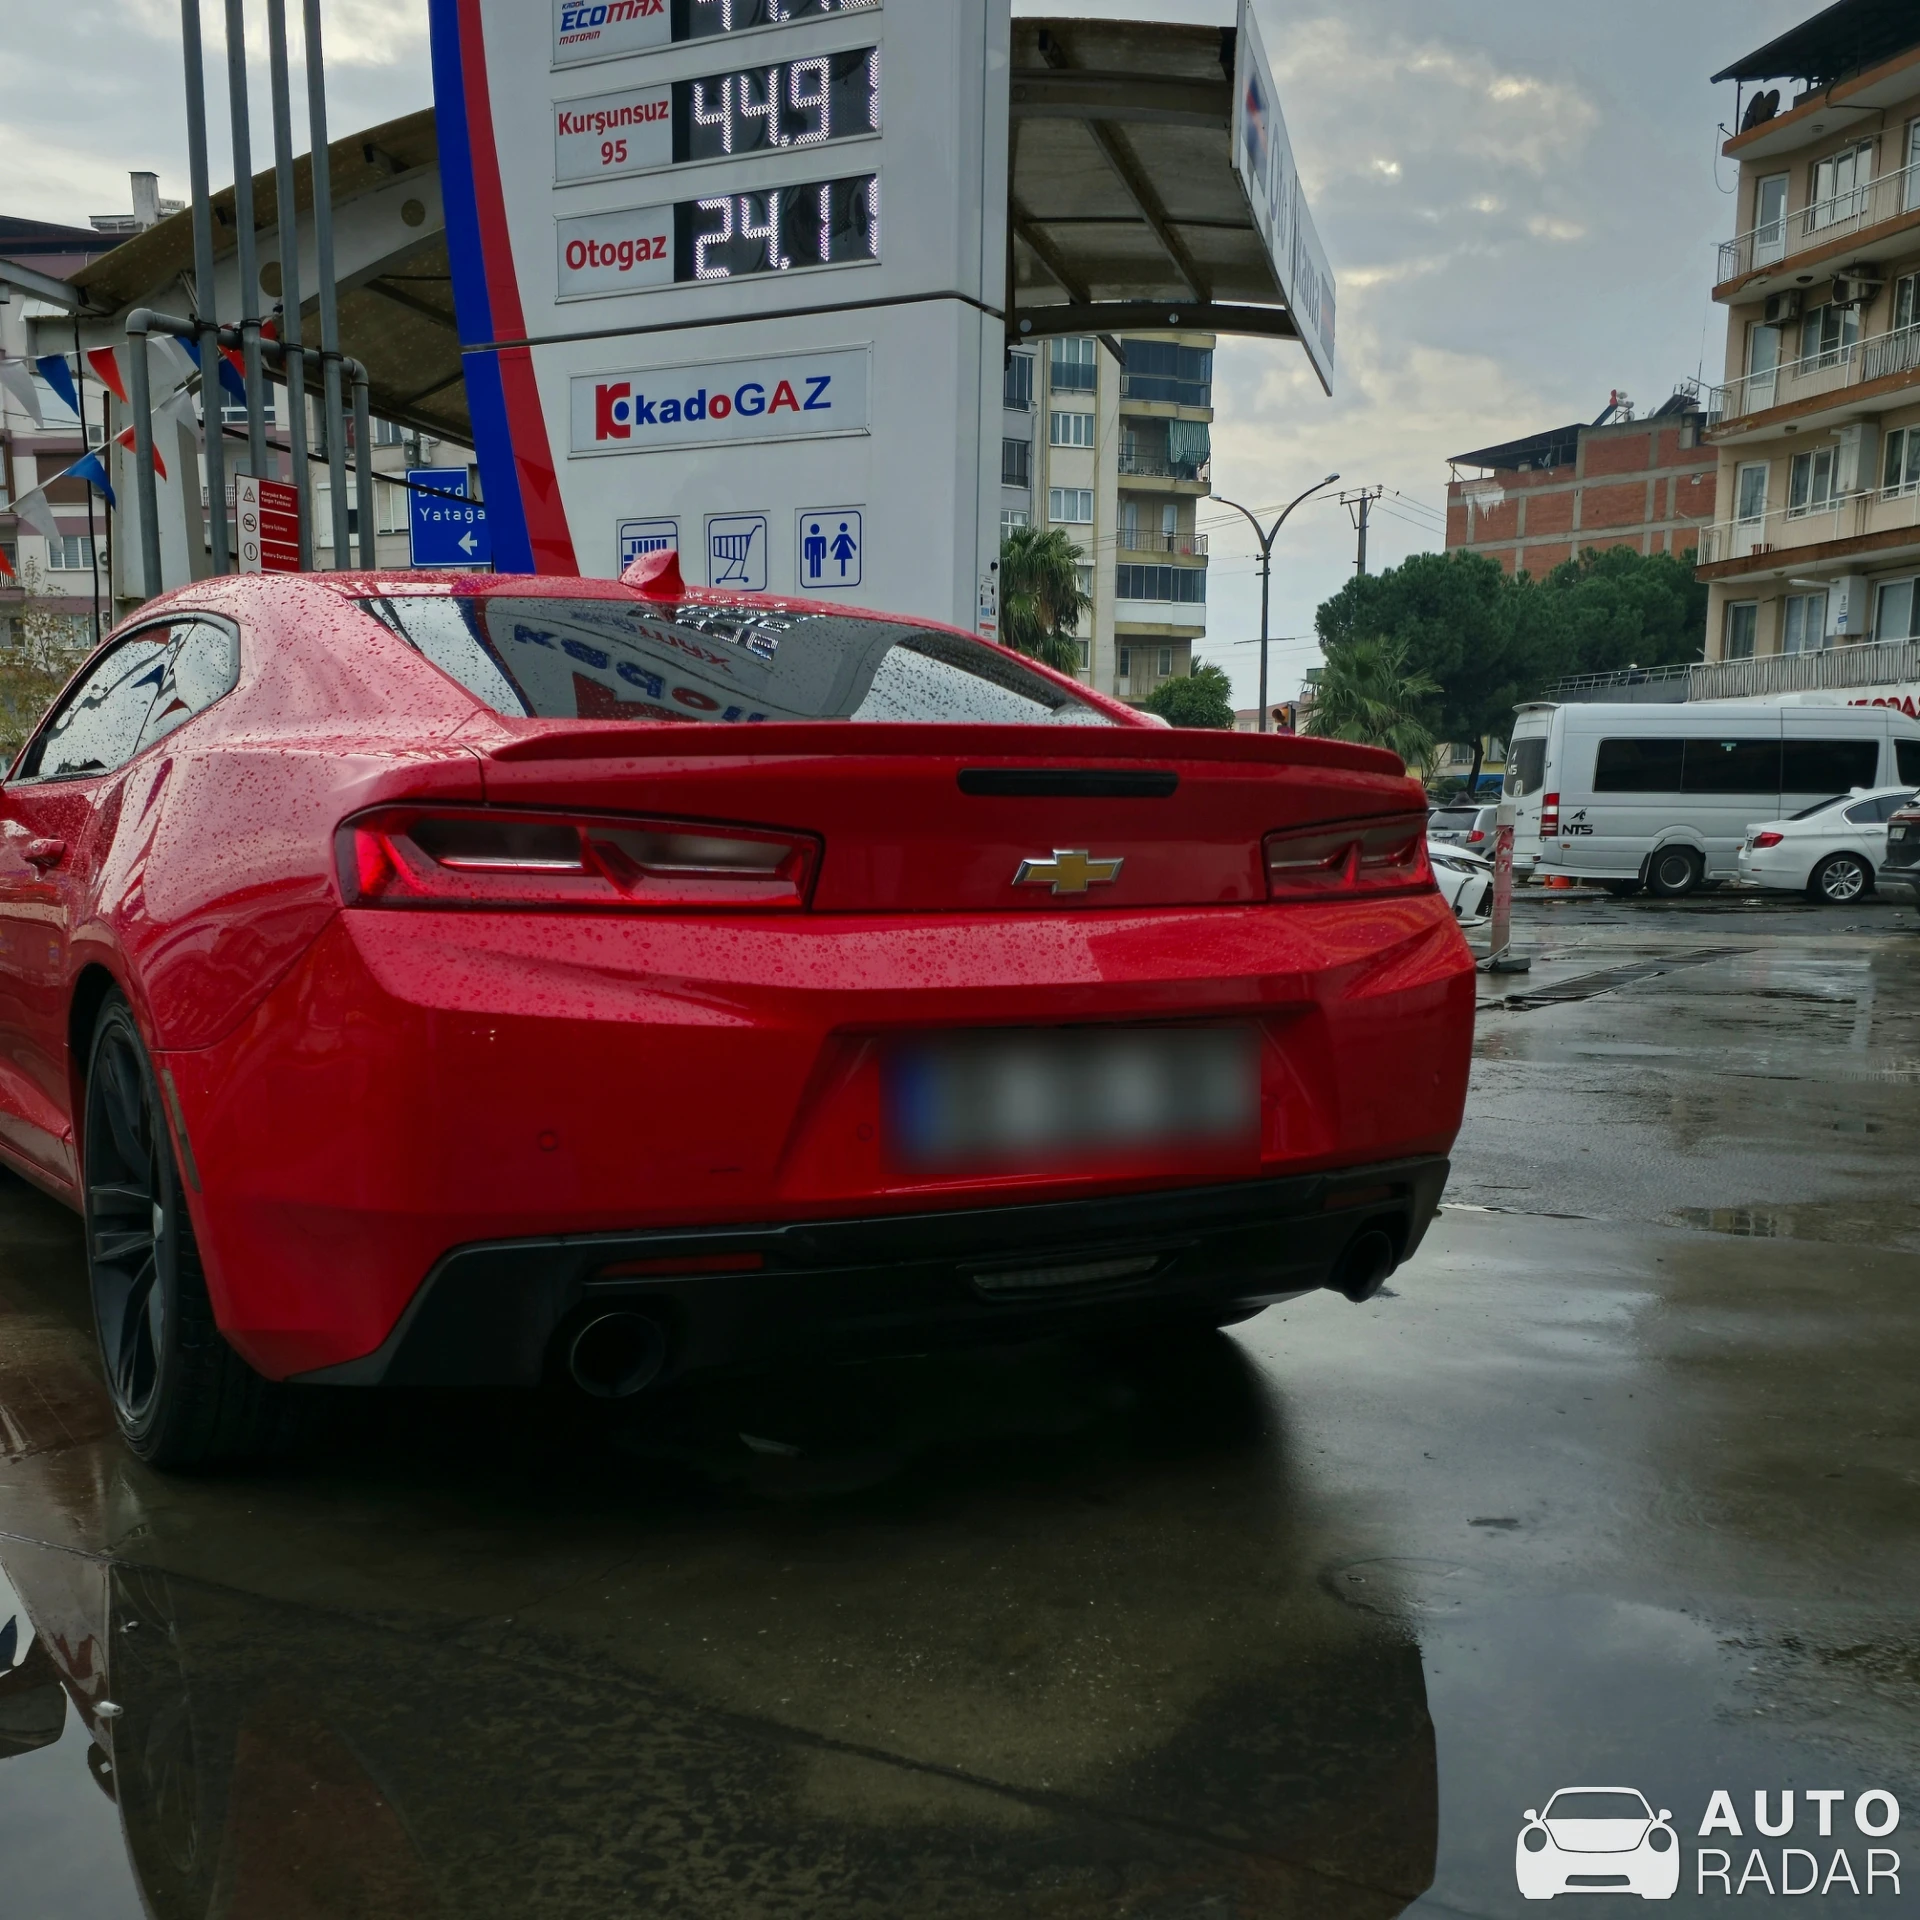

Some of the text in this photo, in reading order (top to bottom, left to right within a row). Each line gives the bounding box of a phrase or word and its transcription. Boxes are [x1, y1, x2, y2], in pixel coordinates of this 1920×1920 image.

[560, 0, 665, 32] ECOMAX
[558, 100, 669, 136] Kurşunsuz
[600, 138, 628, 166] 95
[565, 234, 667, 272] Otogaz
[1562, 824, 1594, 835] NTS
